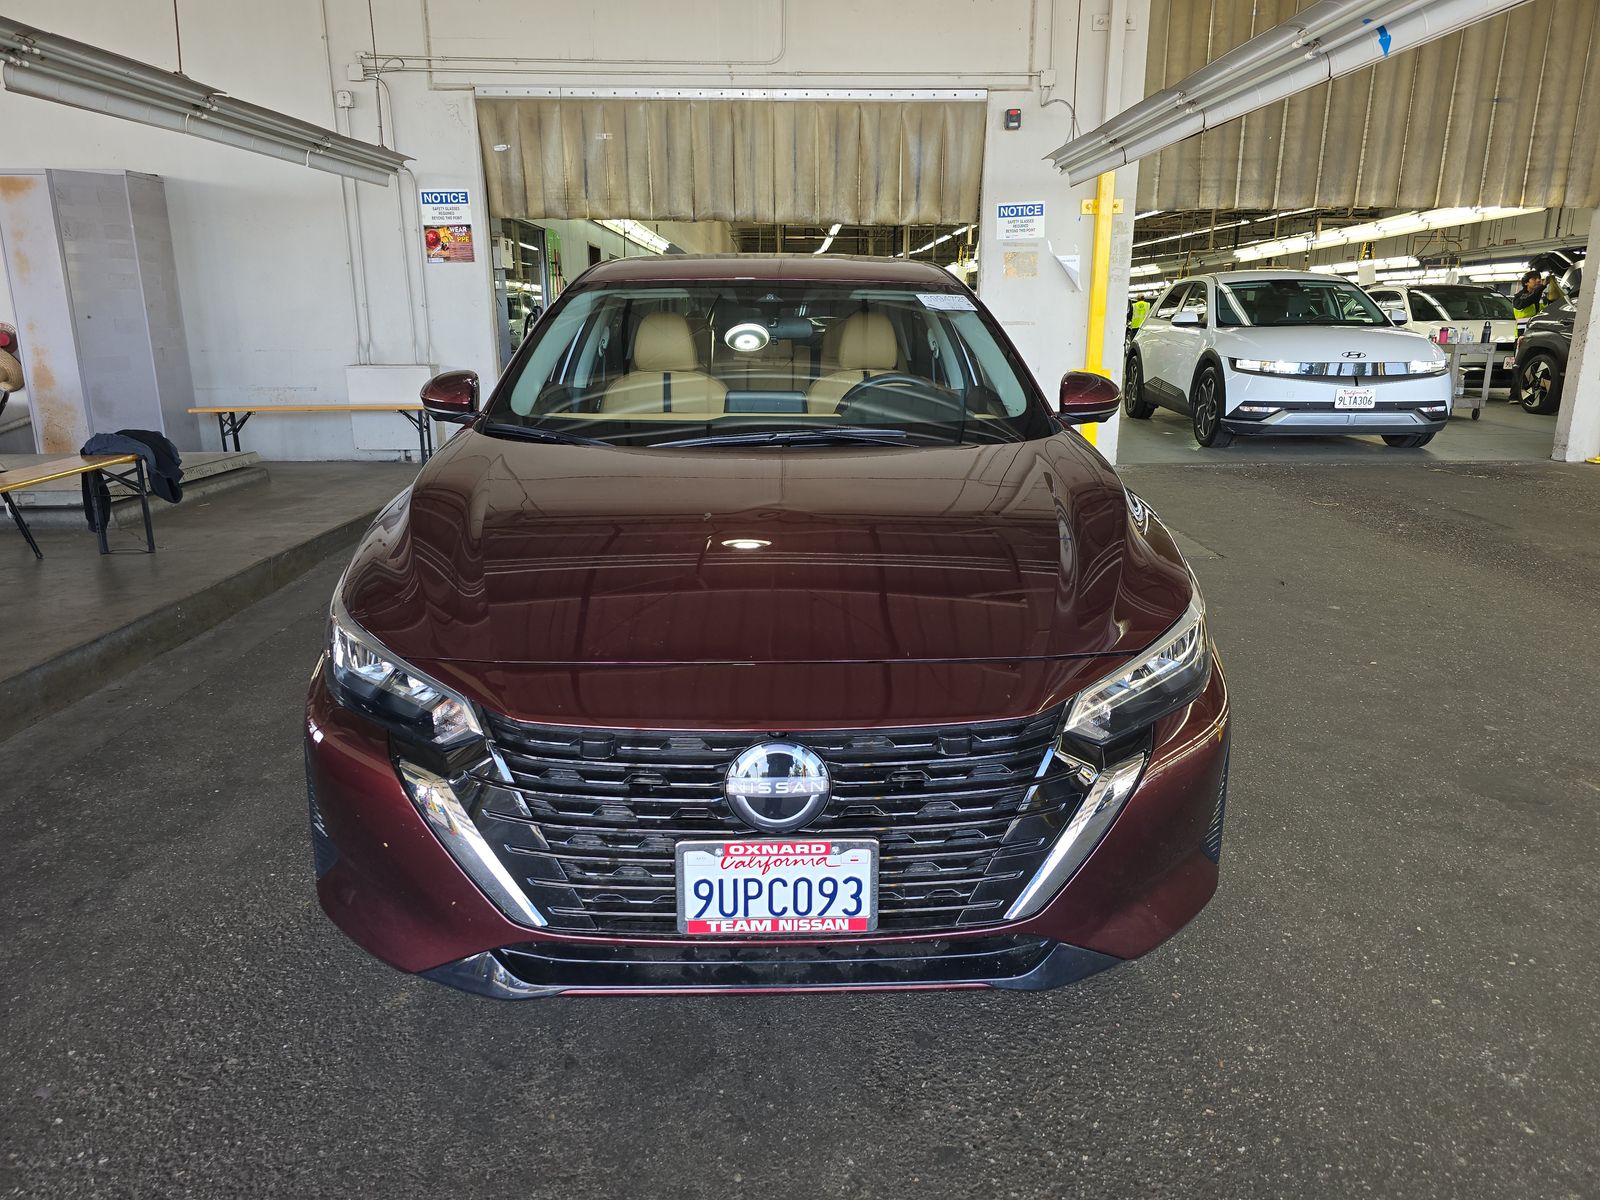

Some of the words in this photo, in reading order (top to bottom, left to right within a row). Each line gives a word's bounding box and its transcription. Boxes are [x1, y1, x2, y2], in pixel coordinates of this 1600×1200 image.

[423, 193, 466, 203] NOTICE
[1000, 205, 1041, 216] NOTICE
[1338, 396, 1373, 405] 9LTA306
[732, 781, 824, 794] NISSAN
[729, 844, 826, 855] OXNARD
[720, 856, 841, 875] California
[693, 876, 863, 918] 9UPC093
[706, 920, 771, 932] TEAM
[778, 919, 849, 931] NISSAN
